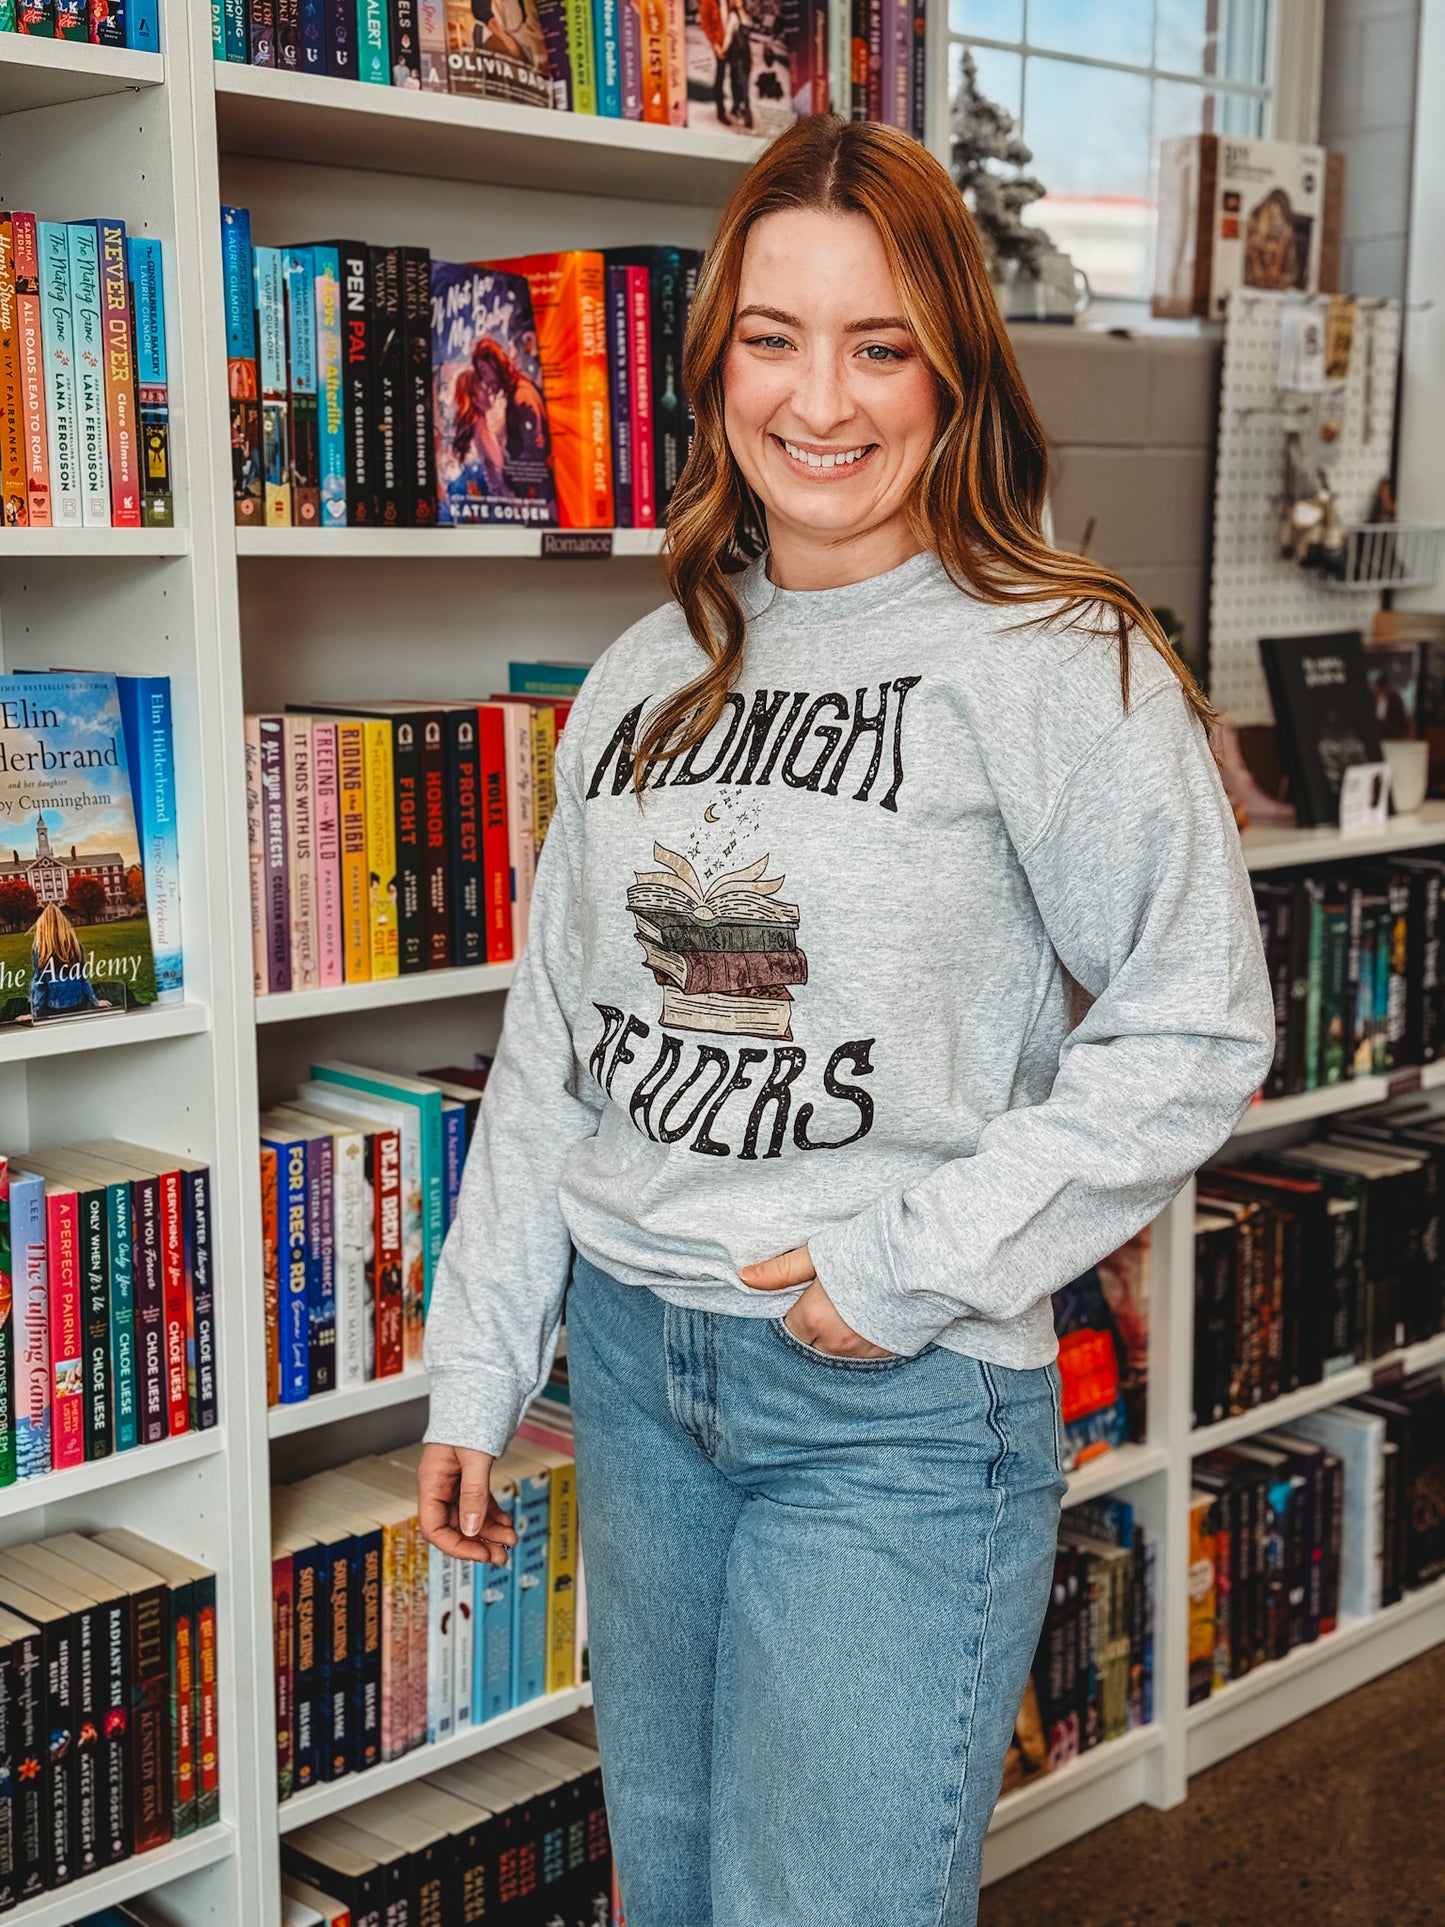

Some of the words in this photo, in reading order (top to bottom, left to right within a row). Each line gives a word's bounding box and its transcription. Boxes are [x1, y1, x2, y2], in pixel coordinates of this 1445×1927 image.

[448, 54, 514, 79] OLIVIA
[650, 38, 662, 78] LIST
[50, 232, 66, 254] The
[77, 234, 94, 256] The
[228, 230, 238, 272] LAURIE
[48, 257, 68, 301] Mating
[76, 259, 96, 303] Mating
[104, 227, 125, 309] NEVER
[140, 265, 149, 302] LAURIE
[346, 259, 365, 311] PEN
[148, 261, 158, 333] GINGERBREAD
[230, 276, 239, 329] GILMORE
[265, 274, 273, 310] LAURIE
[324, 285, 336, 326] Love
[24, 302, 34, 324] ALL
[53, 308, 71, 342] Game
[80, 309, 99, 344] Game
[142, 307, 151, 355] GILMORE
[26, 328, 38, 373] ROADS
[109, 319, 129, 381] OVER
[152, 335, 160, 376] BAKERY
[349, 321, 365, 364] PAL
[5, 356, 13, 377] IVY
[28, 378, 39, 410] LEAD
[56, 373, 65, 410] LANA
[83, 374, 93, 411] LANA
[118, 393, 126, 426] Clare
[7, 386, 18, 462] FAIRBANKS
[31, 414, 39, 431] TO
[32, 435, 42, 472] ROME
[58, 416, 70, 491] FERGUSON
[86, 417, 97, 491] FERGUSON
[120, 431, 129, 481] Gilmore
[355, 406, 365, 484] GEISSINGER
[384, 406, 393, 488] GEISSINGER
[416, 404, 426, 486] GEISSINGER
[450, 504, 489, 518] KATE
[494, 506, 549, 520] GOLDEN
[545, 535, 610, 551] Romance
[2, 699, 59, 729] Elin
[152, 694, 164, 723] Elin
[266, 741, 279, 762] ALL
[294, 734, 306, 747] IT
[342, 729, 361, 790] RIDING
[154, 730, 170, 823] Hilderbrand
[295, 753, 308, 791] ENDS
[316, 729, 334, 796] FREEING
[19, 792, 111, 810] Cunningham
[24, 780, 34, 788] her
[38, 779, 67, 789] daughter
[268, 767, 280, 800] YOUR
[296, 796, 309, 834] WITH
[400, 777, 416, 845] FIGHT
[426, 771, 443, 847] HONOR
[458, 762, 476, 862] PROTECT
[269, 804, 283, 868] PERFECTS
[298, 840, 310, 858] US
[319, 818, 336, 860] WILD
[345, 813, 363, 853] HIGH
[153, 836, 167, 890] Five-Star
[272, 876, 282, 919] COLLEEN
[300, 874, 308, 916] COLLEEN
[156, 893, 168, 945] Weekend
[274, 922, 284, 962] HOOVER
[375, 930, 384, 958] CUTE
[388, 928, 398, 956] MEET
[36, 951, 141, 985] Academy
[589, 1001, 876, 1160] READERS
[288, 1147, 304, 1190] FOR
[380, 1138, 398, 1191] DEJA
[30, 1200, 38, 1222] LEE
[60, 1204, 70, 1214] A
[143, 1187, 153, 1216] WITH
[167, 1177, 177, 1249] EVERYTHING
[194, 1178, 204, 1207] EVER
[89, 1200, 99, 1230] ONLY
[116, 1189, 126, 1238] ALWAYS
[145, 1220, 153, 1245] YOU
[195, 1210, 206, 1244] AFTER
[380, 1195, 399, 1250] BREW
[27, 1240, 46, 1280] The
[61, 1219, 72, 1287] PERFECT
[91, 1234, 100, 1270] WHEN
[115, 1243, 129, 1269] Only
[144, 1249, 156, 1289] Forever
[115, 1274, 129, 1298] You
[24, 1285, 48, 1362] Cuffing
[63, 1294, 74, 1357] PAIRING
[169, 1321, 180, 1364] CHLOE
[200, 1320, 211, 1362] CHLOE
[349, 1319, 357, 1360] MANN
[93, 1347, 103, 1391] CHLOE
[119, 1333, 130, 1375] CHLOE
[146, 1332, 158, 1374] CHLOE
[31, 1368, 49, 1431] Game
[121, 1380, 131, 1415] LIESE
[148, 1378, 159, 1413] LIESE
[171, 1368, 181, 1402] LIESE
[202, 1366, 213, 1400] LIESE
[94, 1394, 105, 1430] LIESE
[300, 1567, 313, 1598] SOUL
[334, 1559, 347, 1590] SOUL
[365, 1551, 378, 1581] SOUL
[82, 1616, 91, 1647] DARK
[138, 1599, 161, 1677] REEL
[296, 1600, 313, 1671] SEARCHING
[330, 1592, 347, 1662] SEARCHING
[362, 1583, 378, 1652] SEARCHING
[110, 1609, 121, 1675] RADIANT
[50, 1661, 59, 1693] RUIN
[59, 1640, 69, 1707] MIDNIGHT
[82, 1650, 92, 1713] RESTRAINT
[111, 1680, 121, 1706] SIN
[82, 1798, 90, 1849] ROBERT
[110, 1786, 120, 1838] ROBERT
[55, 1810, 63, 1862] ROBERT
